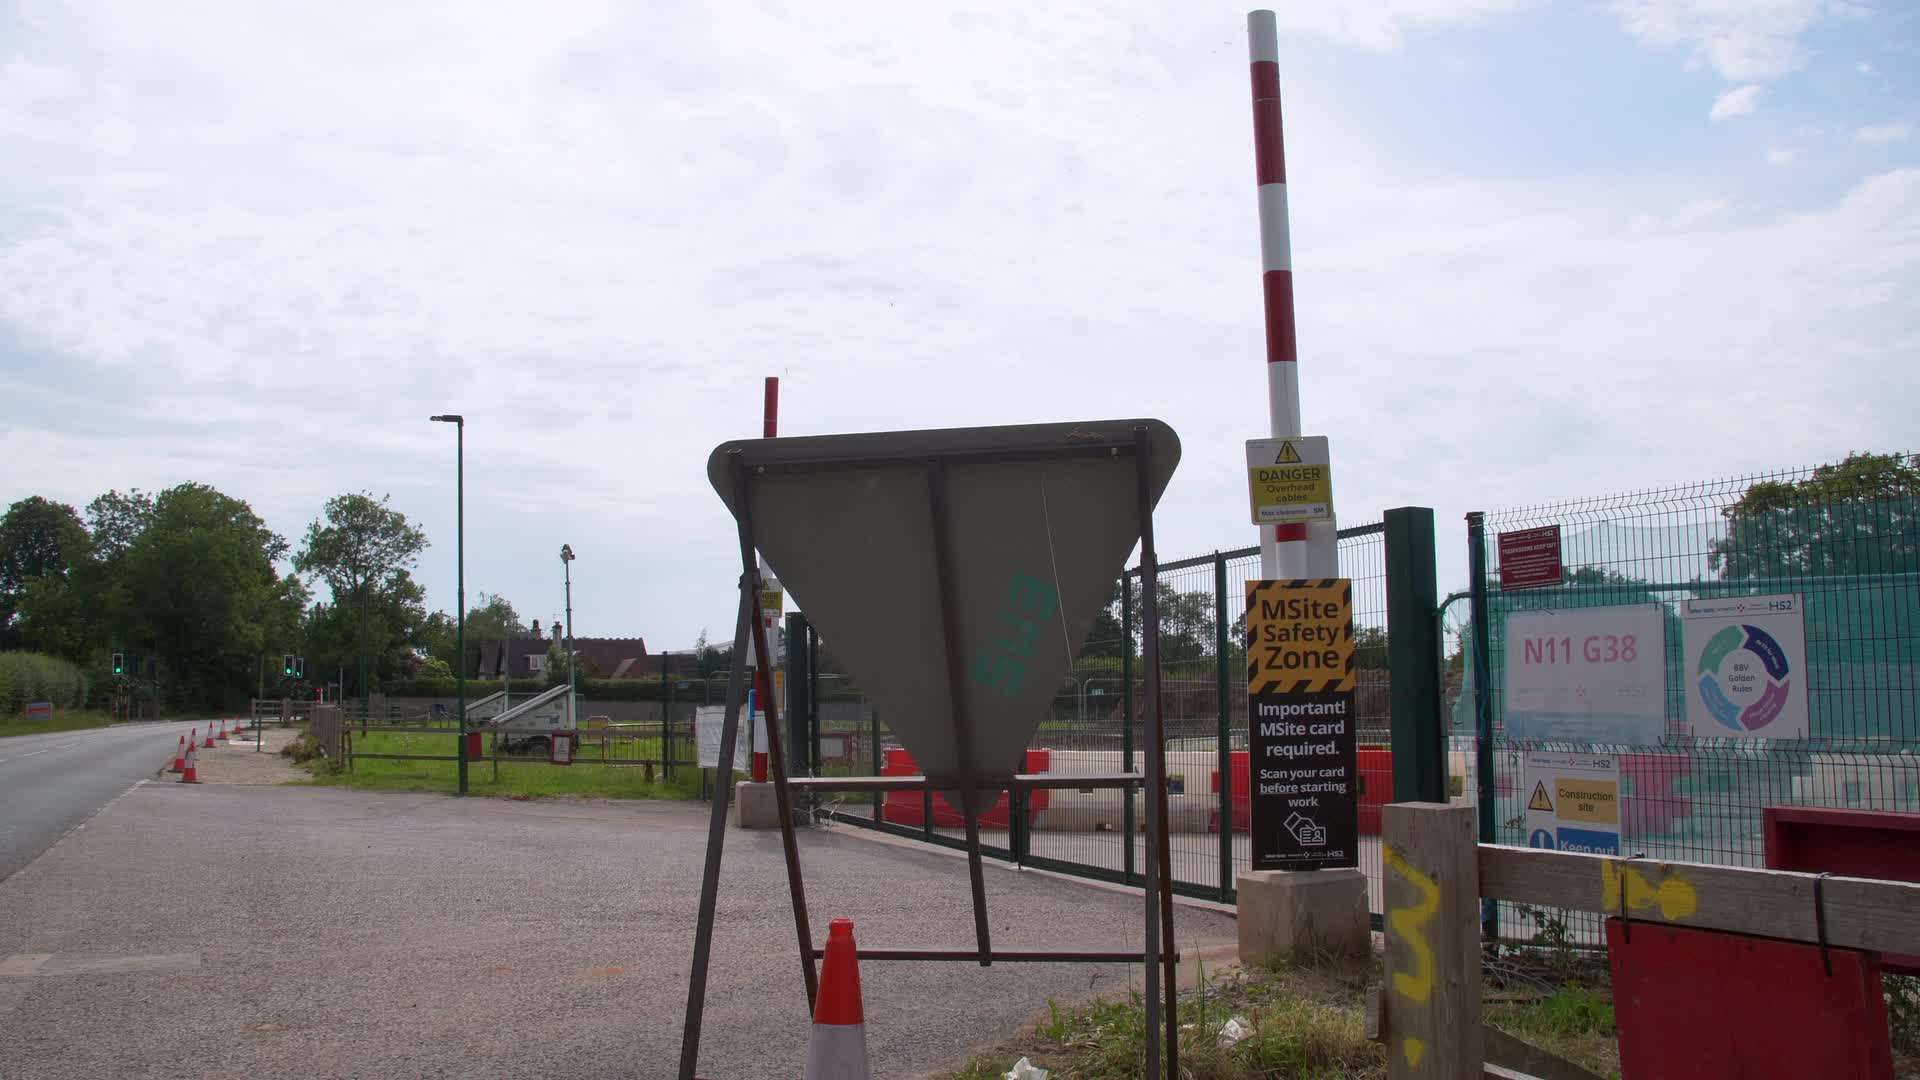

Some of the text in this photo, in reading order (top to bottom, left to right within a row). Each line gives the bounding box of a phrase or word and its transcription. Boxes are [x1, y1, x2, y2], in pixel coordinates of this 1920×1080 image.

[1259, 467, 1321, 481] DANGER
[1266, 482, 1315, 494] Overhead
[1275, 494, 1308, 502] cables
[1262, 598, 1338, 620] MSite
[1768, 600, 1793, 611] HS2
[1263, 622, 1340, 646] Safety
[1524, 634, 1637, 665] N11 G38
[1264, 646, 1339, 670] Zone
[1728, 674, 1756, 682] Golden
[1731, 684, 1753, 693] Rules
[1258, 700, 1346, 719] Important!
[1260, 720, 1345, 737] MSite card
[1266, 740, 1340, 760] required.
[1592, 760, 1611, 769] HS2
[1260, 766, 1345, 781] Scan your card
[1260, 781, 1346, 794] before starting
[1558, 788, 1614, 801] Construction
[1288, 796, 1319, 808] work
[1578, 802, 1595, 812] site
